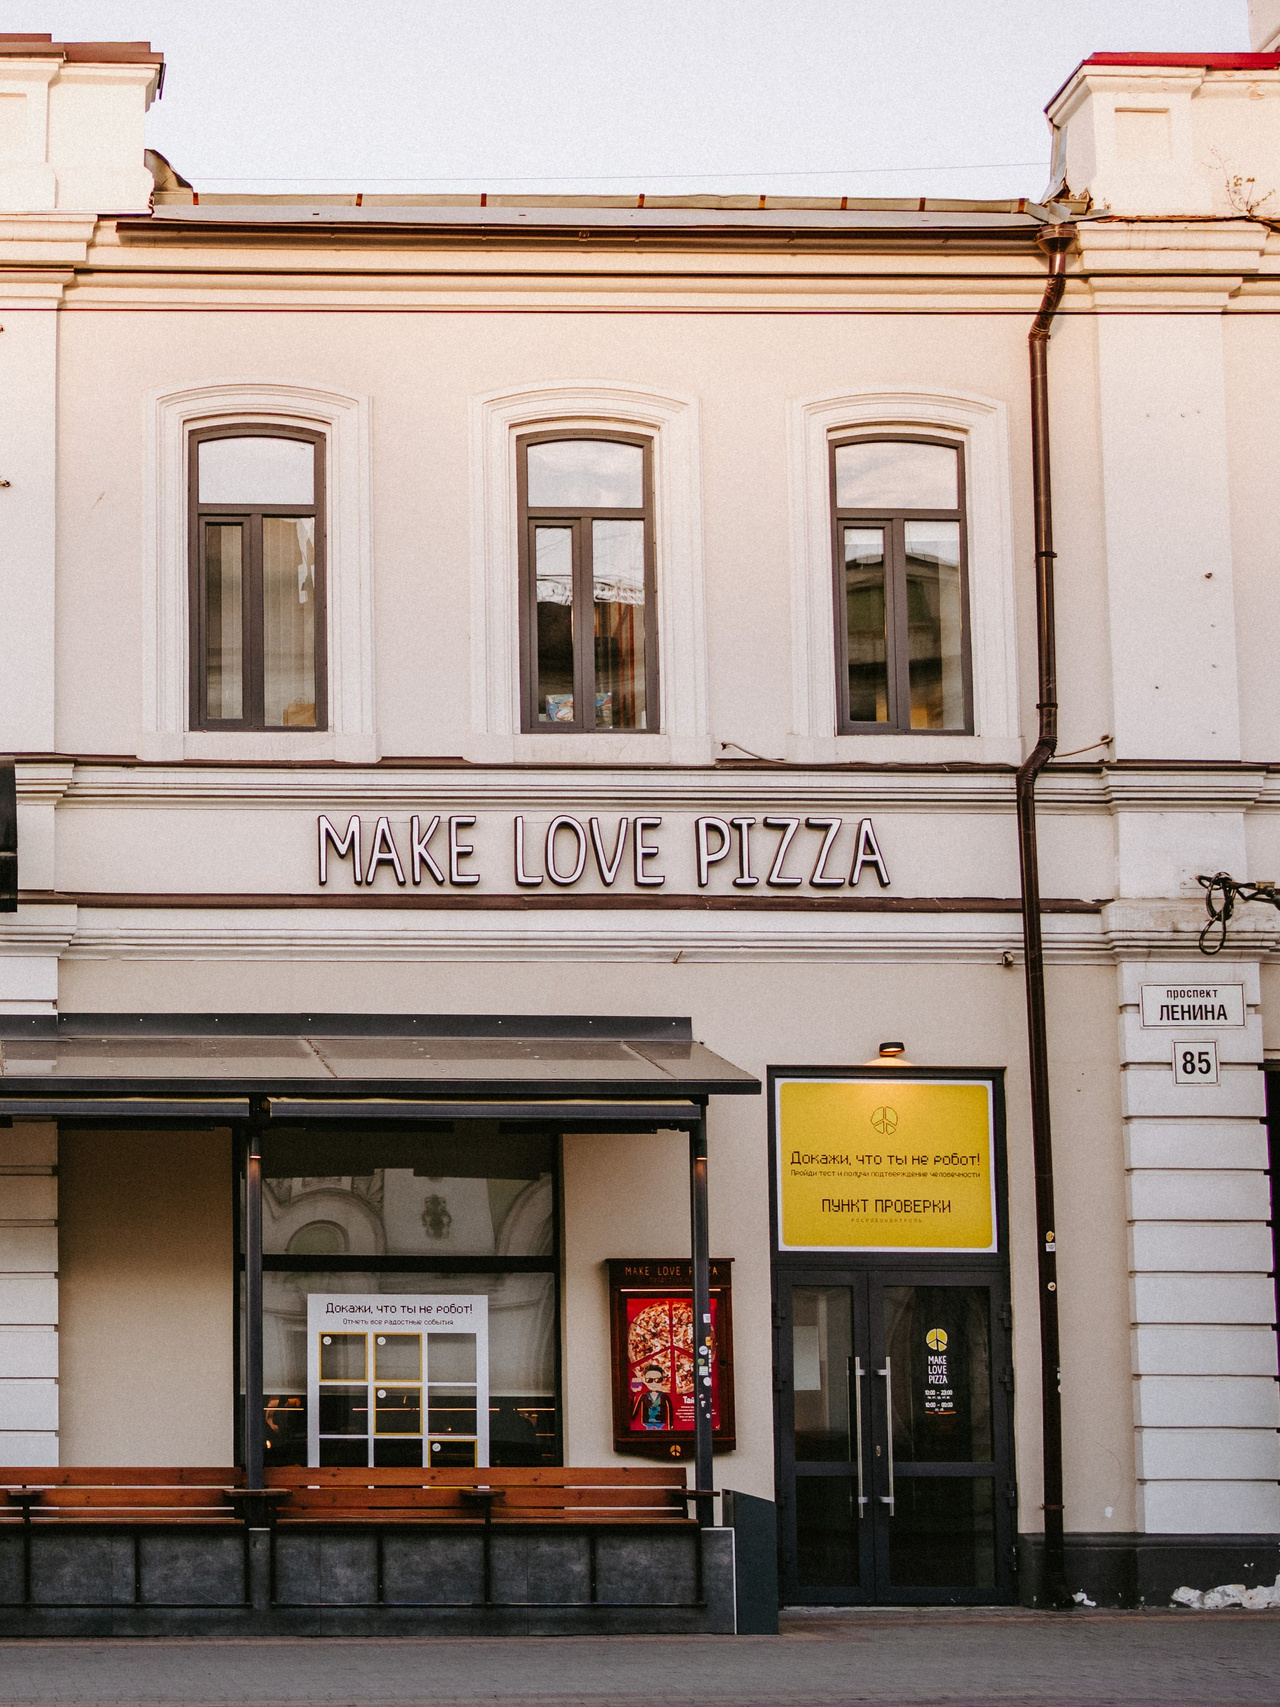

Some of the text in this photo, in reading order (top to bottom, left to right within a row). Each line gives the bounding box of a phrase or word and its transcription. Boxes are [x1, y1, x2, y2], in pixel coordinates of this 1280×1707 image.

[318, 814, 892, 888] MAKE LOVE PIZZA
[1167, 989, 1218, 1000] проспект
[1160, 1004, 1228, 1021] ЛЕНИНА
[1182, 1051, 1211, 1074] 85
[791, 1151, 980, 1166] Докажи, что ты не робот!
[822, 1199, 951, 1213] ПУНКТ ПРОВЕРКИ
[625, 1267, 649, 1276] MAKE
[658, 1266, 680, 1276] LOVE
[326, 1303, 473, 1315] Докажи, что ты не робот!
[928, 1356, 947, 1364] MAKE
[928, 1365, 947, 1374] LOVE
[928, 1375, 948, 1384] PIZZA
